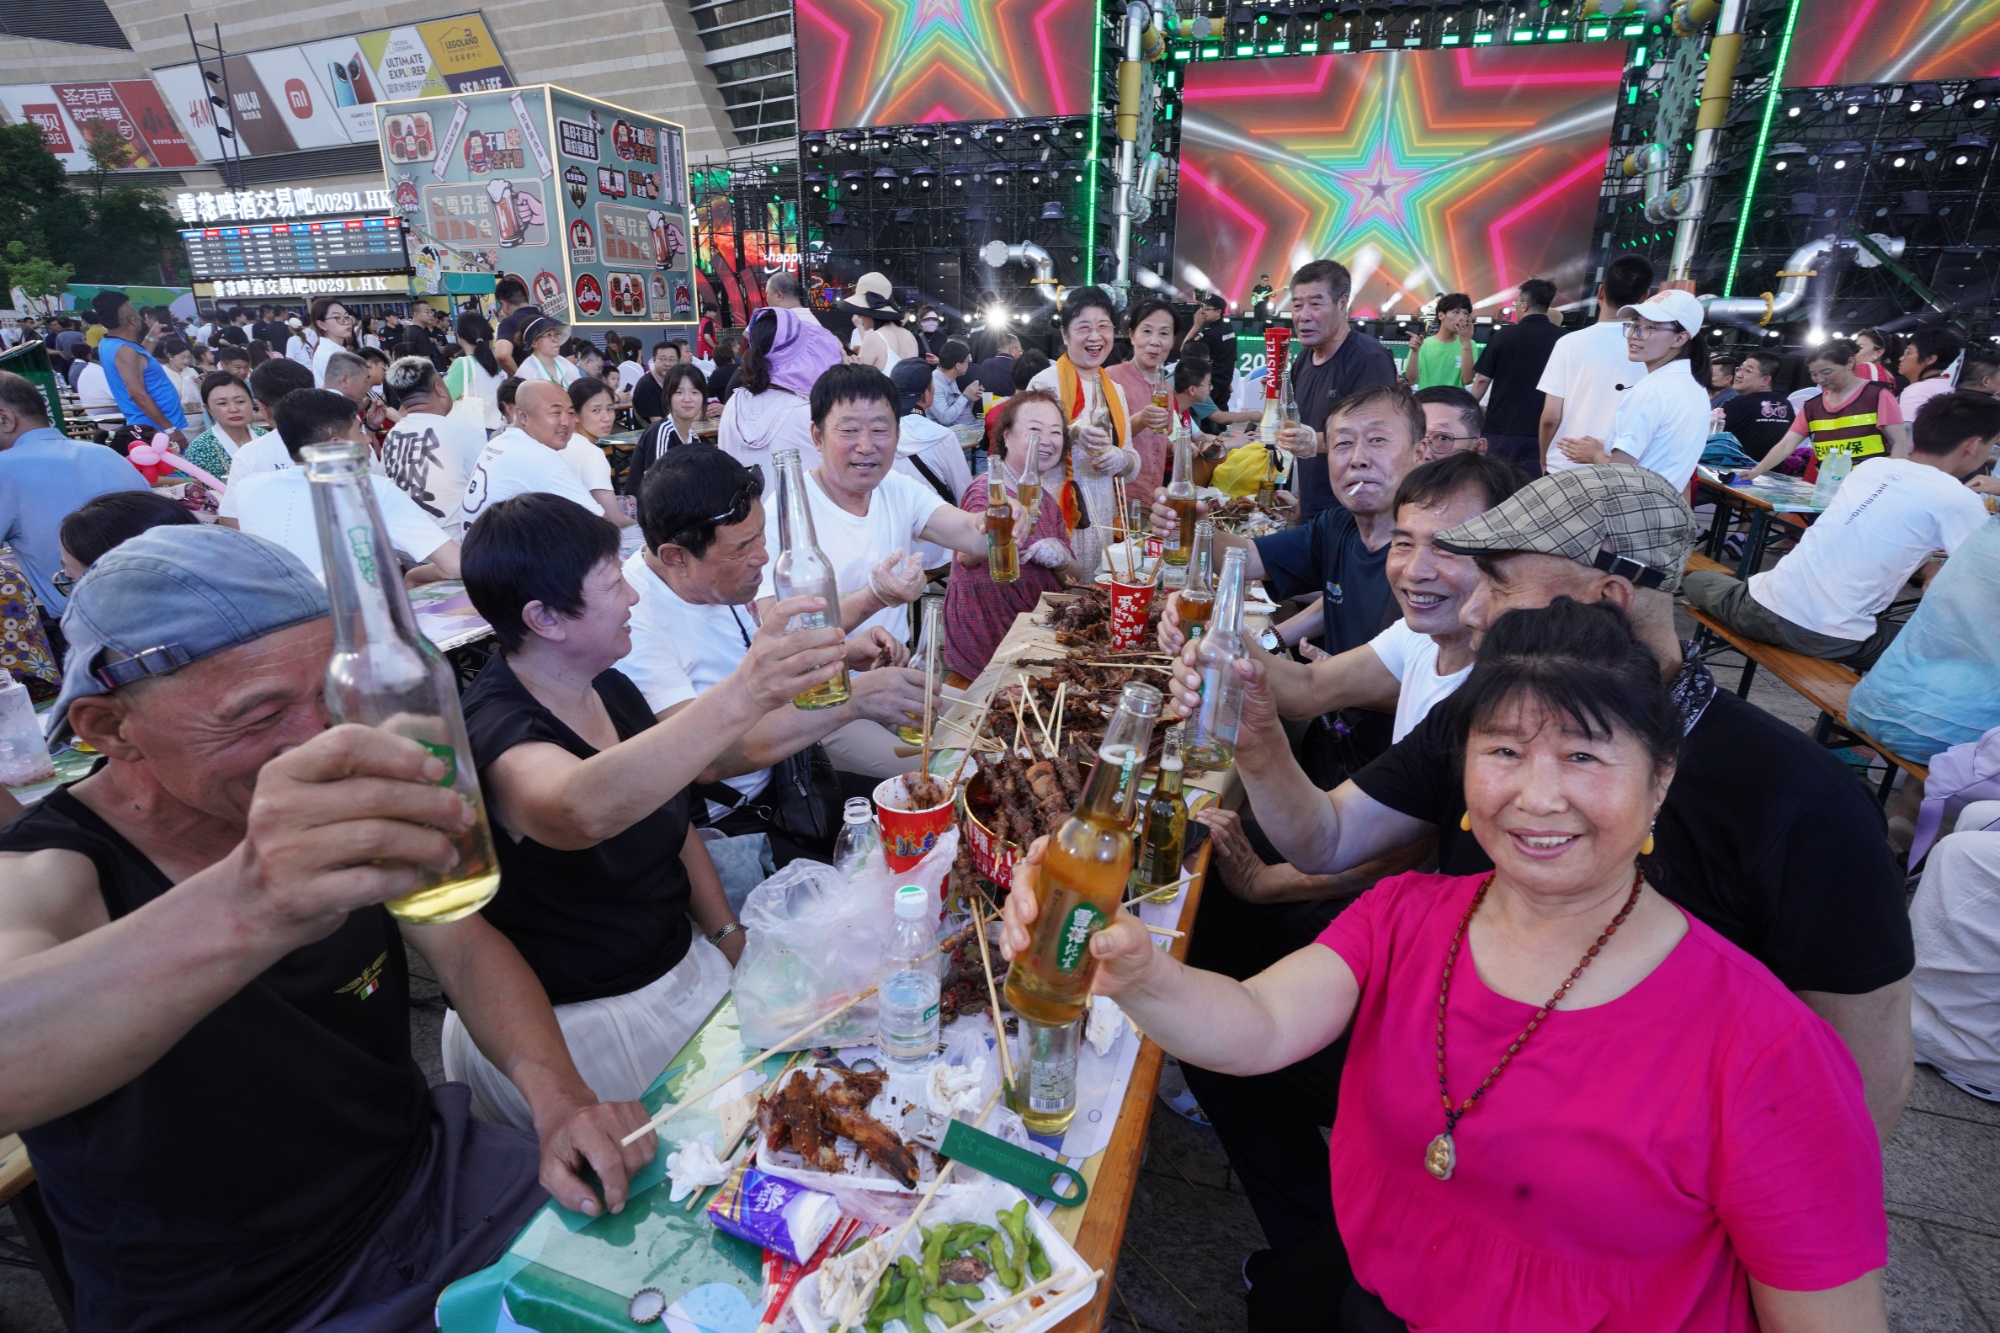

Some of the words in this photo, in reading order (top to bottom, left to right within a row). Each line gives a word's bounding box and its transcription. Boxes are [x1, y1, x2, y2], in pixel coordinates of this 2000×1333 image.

[445, 36, 479, 50] LEGOLAND
[385, 54, 424, 68] ULTIMATE
[389, 65, 427, 80] EXPLORER
[63, 88, 114, 106] 圣有声
[233, 91, 261, 112] MUJI
[177, 187, 395, 223] 雪花啤酒交易吧00291.HK
[212, 275, 389, 297] 雪花啤酒交易吧00291.HK
[1265, 337, 1277, 389] AMSTEL
[1846, 440, 1864, 455] 保
